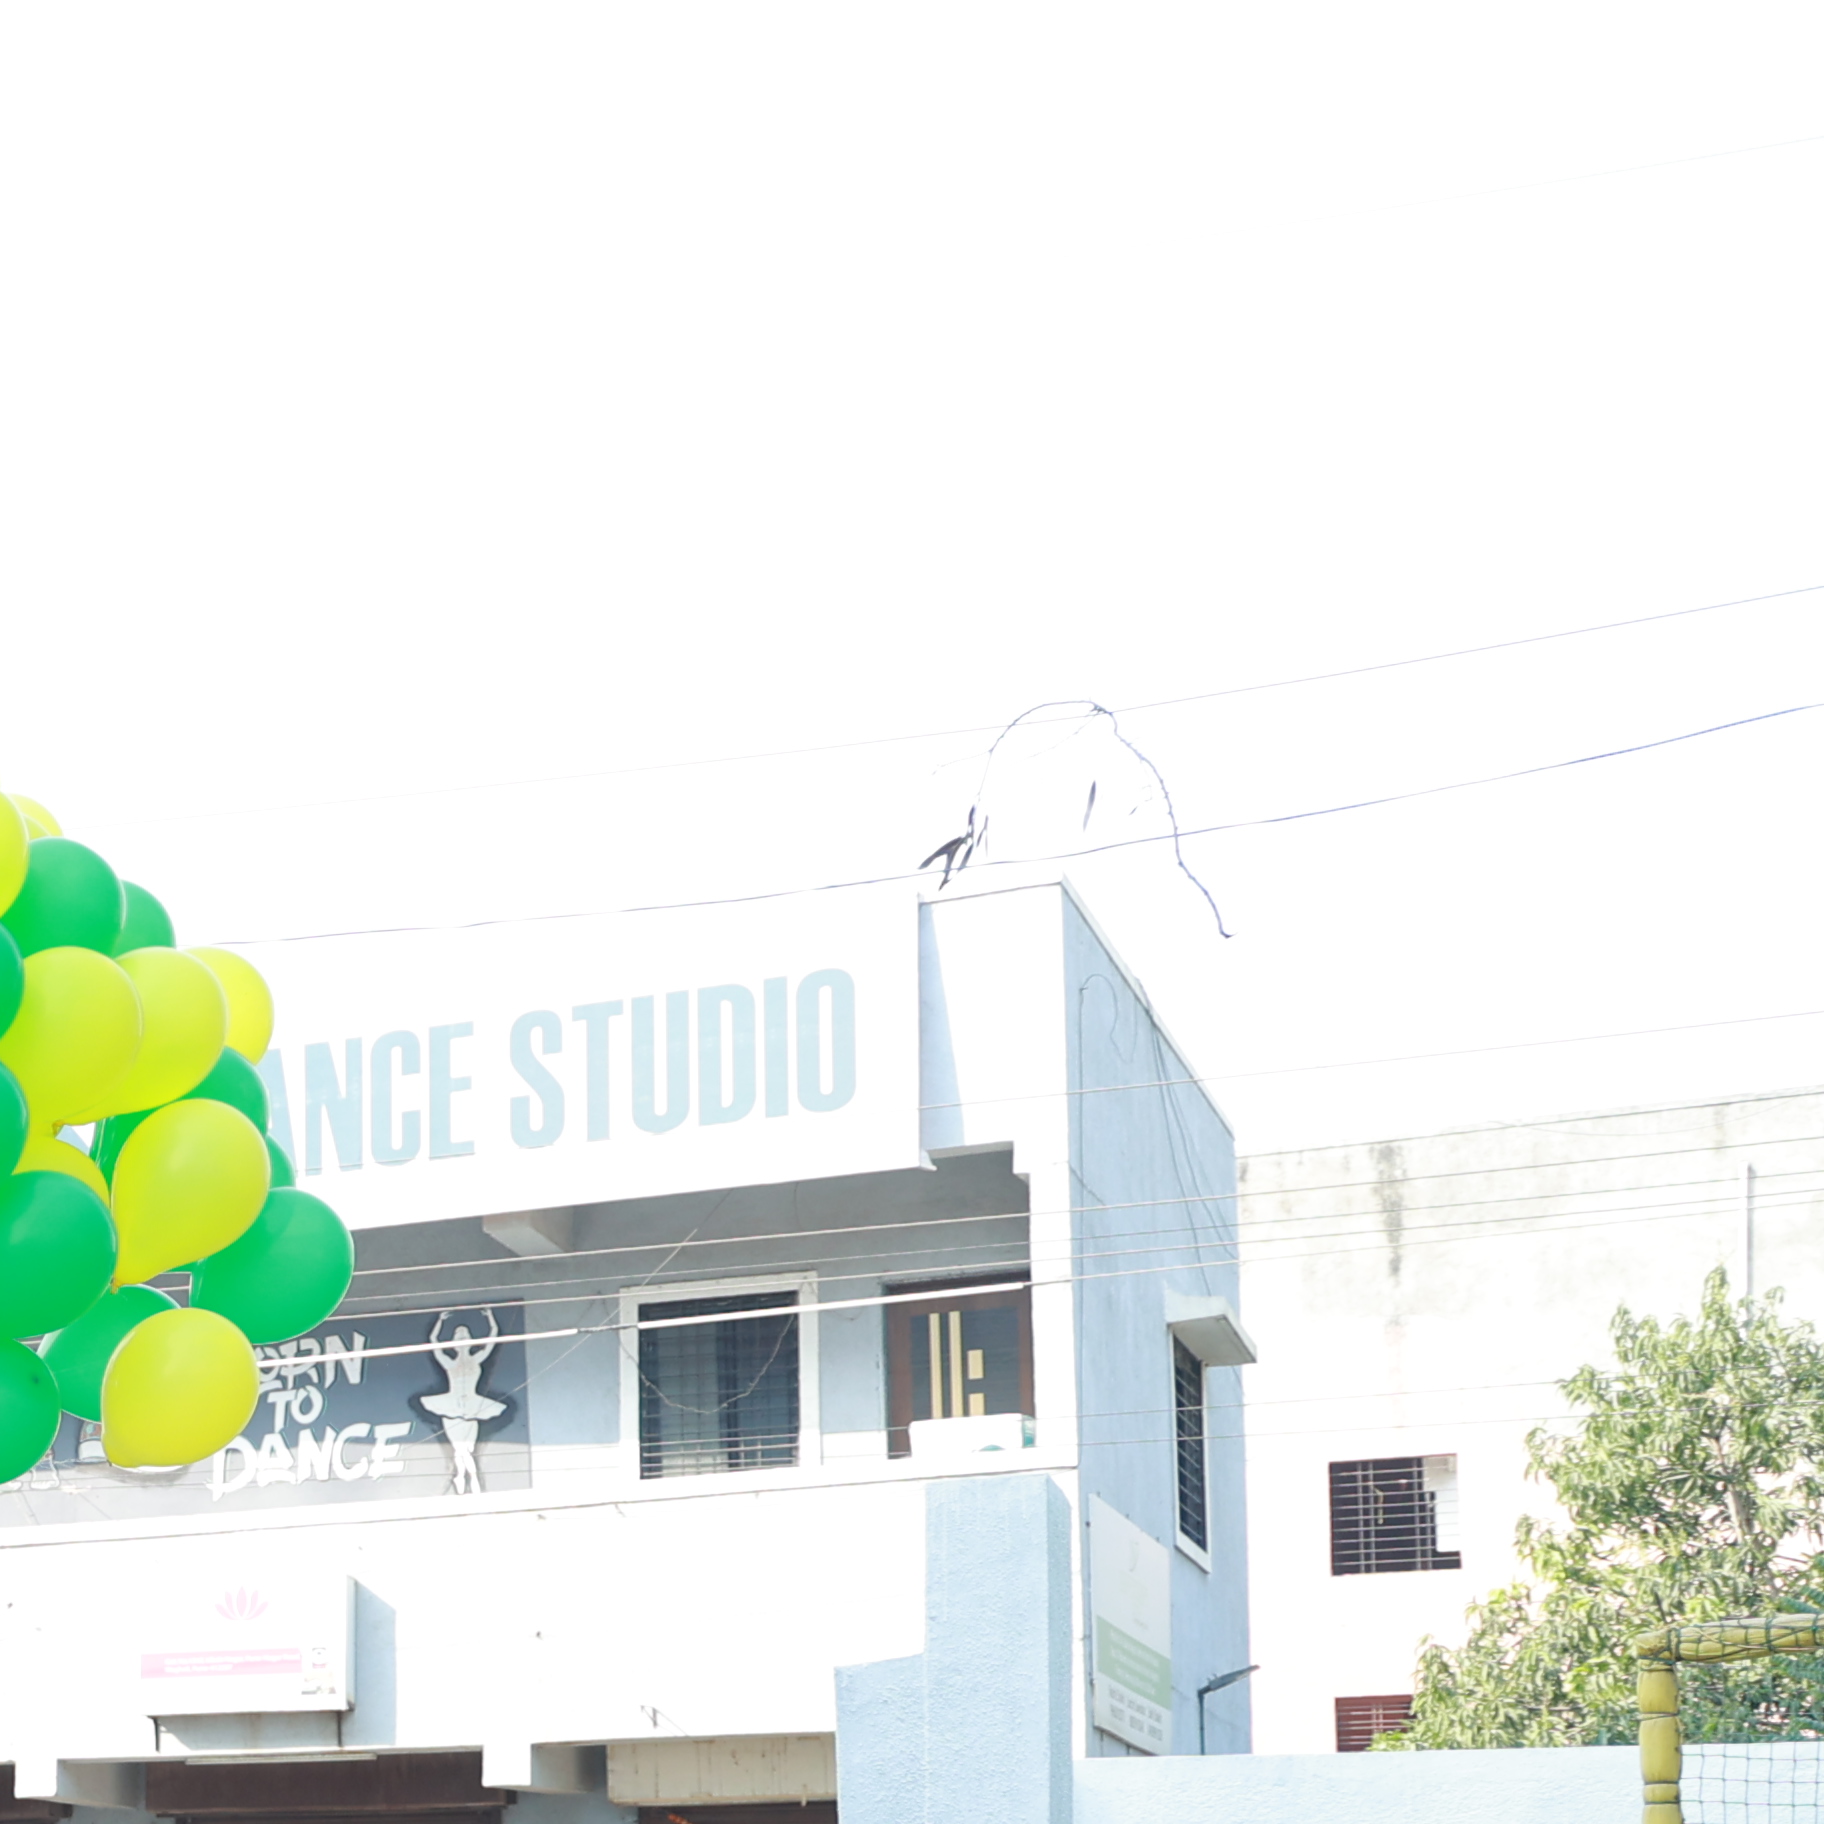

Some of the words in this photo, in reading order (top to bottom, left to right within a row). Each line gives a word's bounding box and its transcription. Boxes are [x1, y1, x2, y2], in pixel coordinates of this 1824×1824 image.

[265, 1021, 474, 1178] ANCE
[507, 967, 857, 1150] STUDIO
[255, 1331, 366, 1389] ORN
[267, 1385, 325, 1432] TO
[205, 1422, 412, 1501] DANCE
